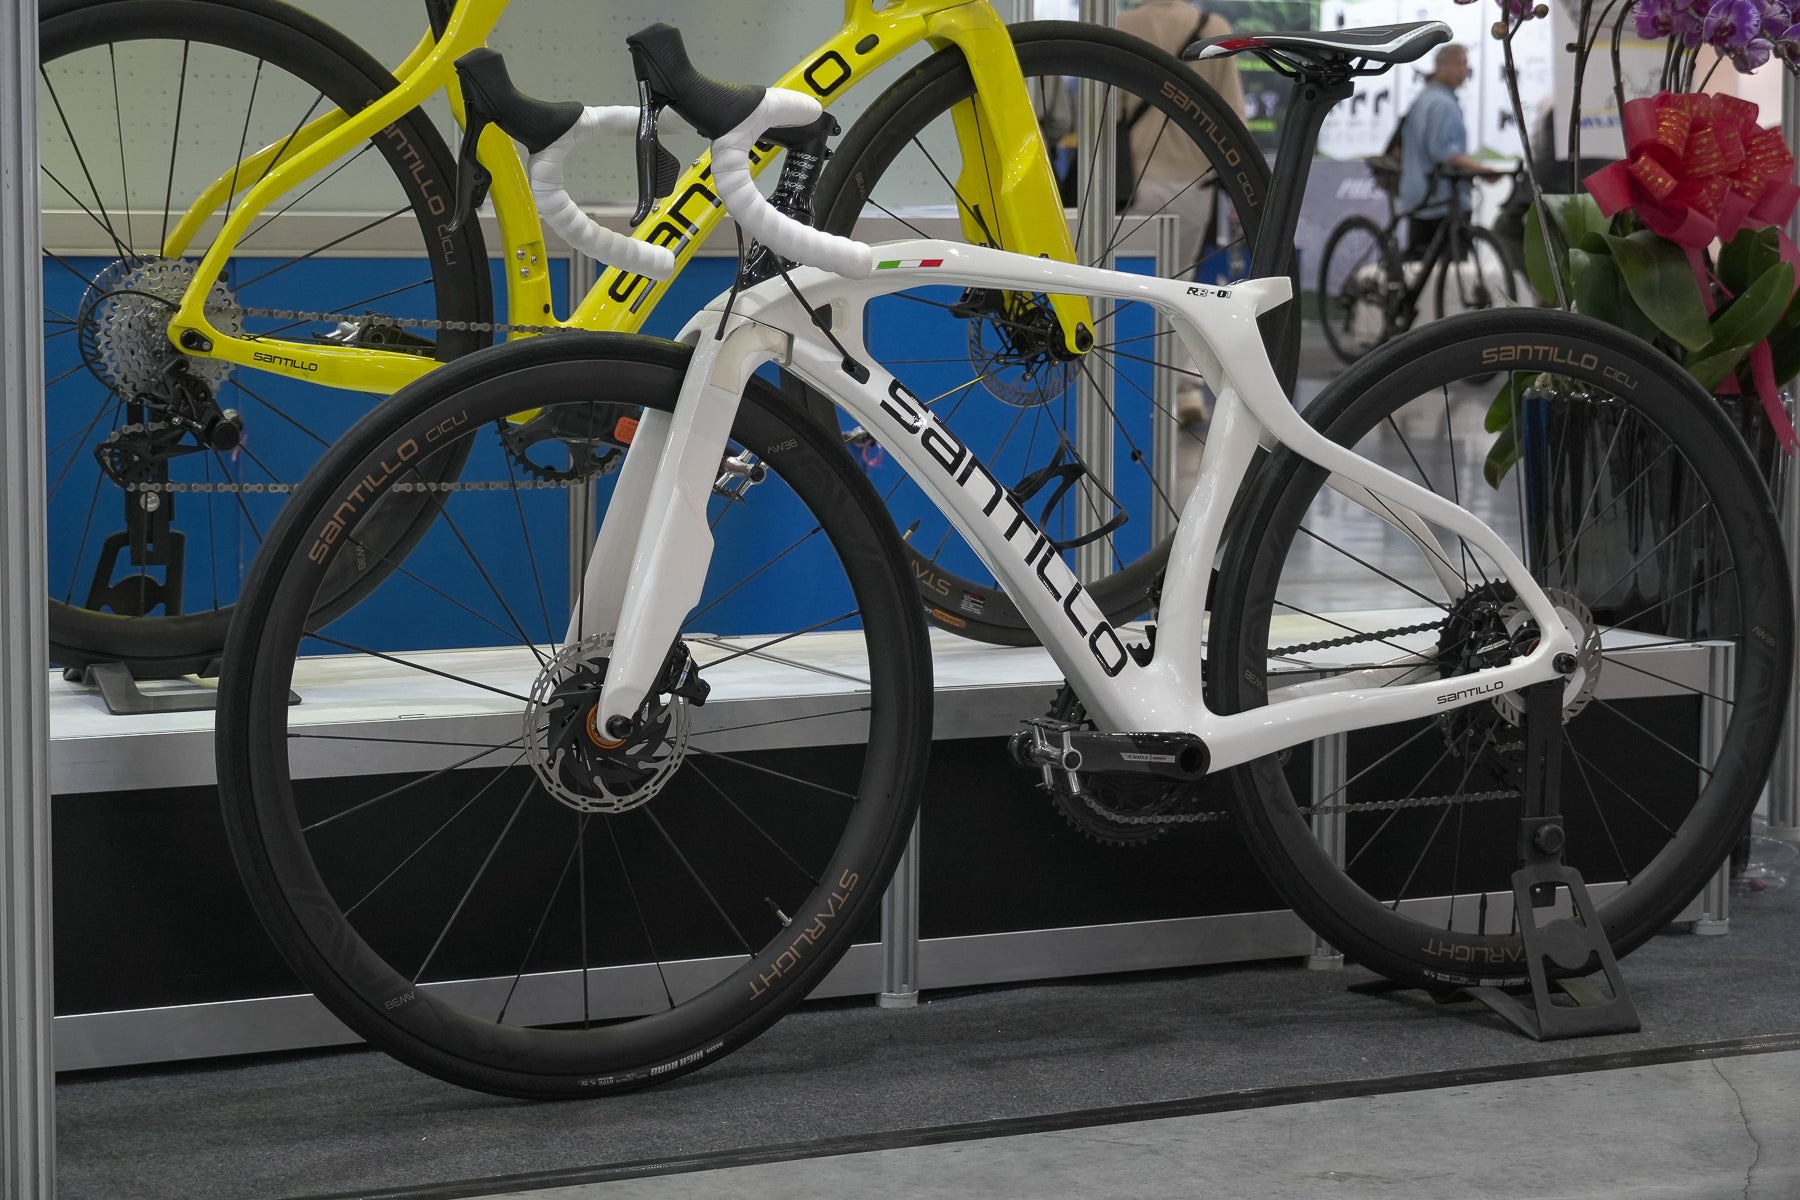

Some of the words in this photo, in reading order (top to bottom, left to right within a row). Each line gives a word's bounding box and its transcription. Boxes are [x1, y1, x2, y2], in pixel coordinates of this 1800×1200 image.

[1160, 81, 1241, 168] SANTILLO
[252, 352, 319, 372] SANTILLO
[1482, 345, 1599, 371] SANTILLO
[1602, 365, 1639, 391] CICLI
[308, 438, 419, 565] SANTILLO
[425, 410, 468, 443] CICLI
[880, 378, 1129, 678] SANTILLO
[1436, 680, 1504, 705] SANTILLO
[749, 868, 860, 1001] STARLIGHT
[1421, 938, 1526, 963] ARLIGHT
[650, 1059, 679, 1076] ROAD
[679, 1050, 704, 1067] HIGH
